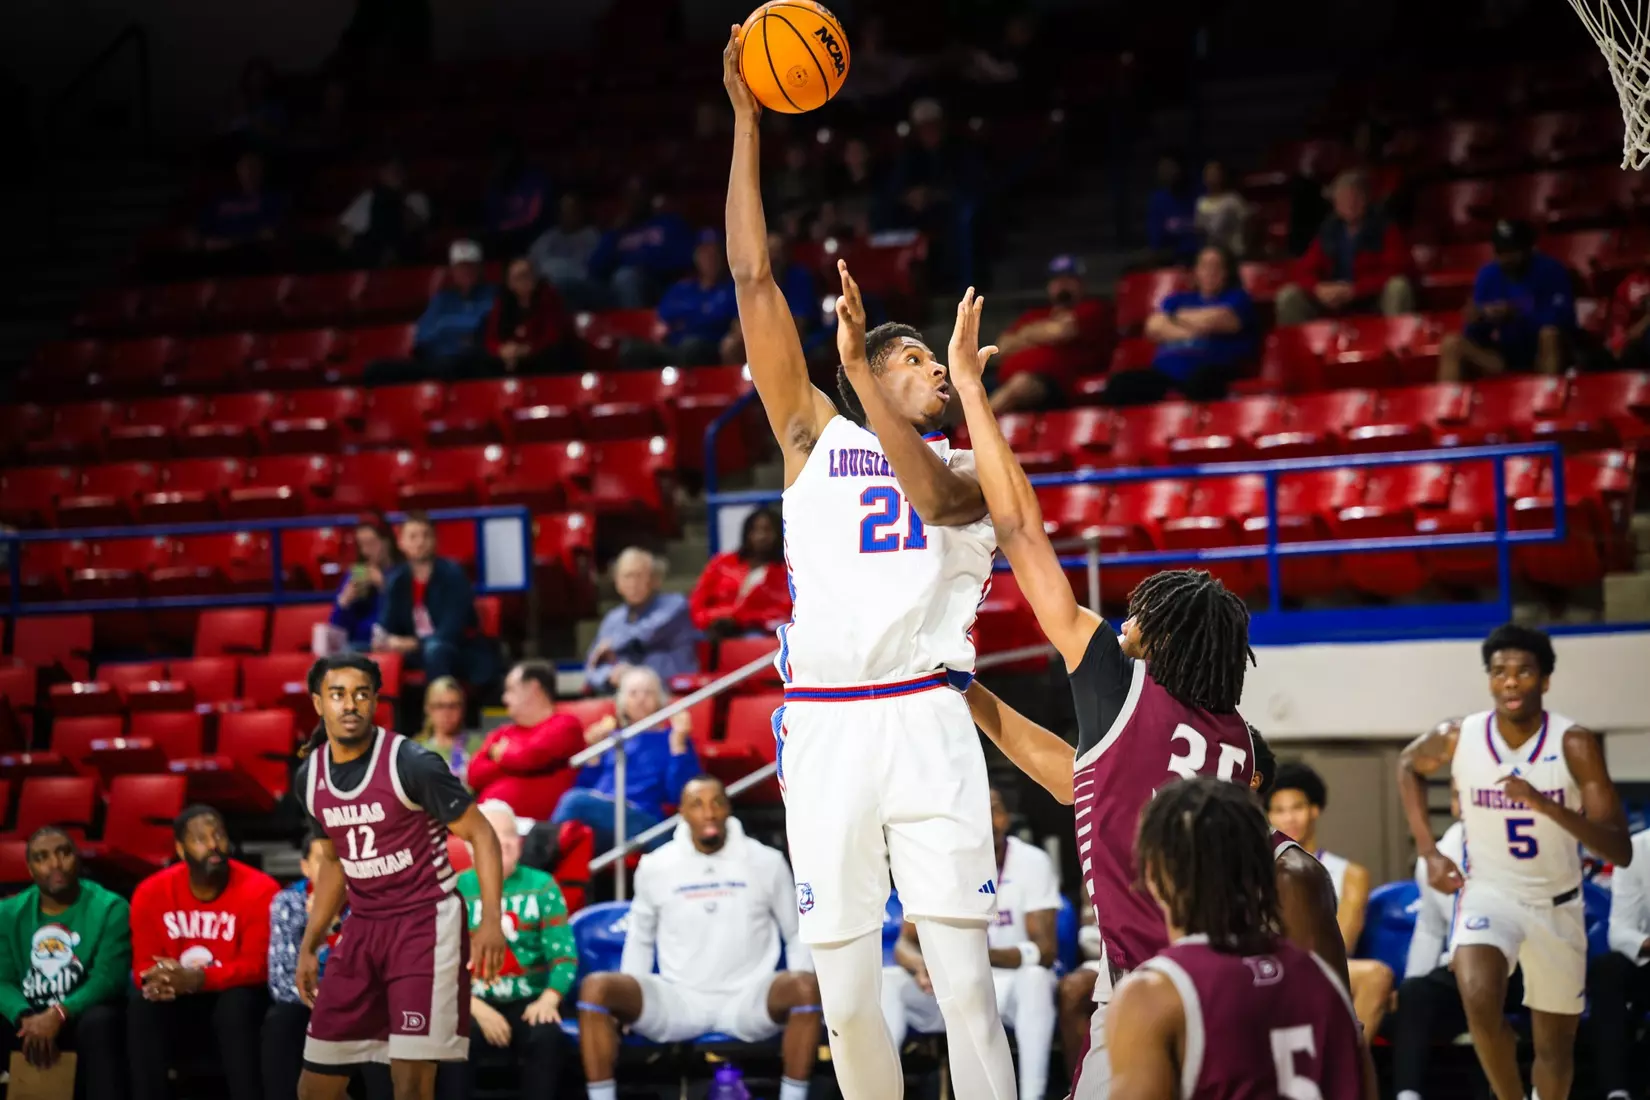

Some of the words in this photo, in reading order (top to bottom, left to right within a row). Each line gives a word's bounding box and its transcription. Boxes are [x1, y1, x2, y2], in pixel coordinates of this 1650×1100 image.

[814, 26, 846, 78] NCAA
[828, 448, 896, 477] LOUISIA
[859, 486, 927, 553] 21
[322, 802, 385, 827] DALLAS
[346, 825, 378, 860] 12
[1505, 817, 1539, 860] 5
